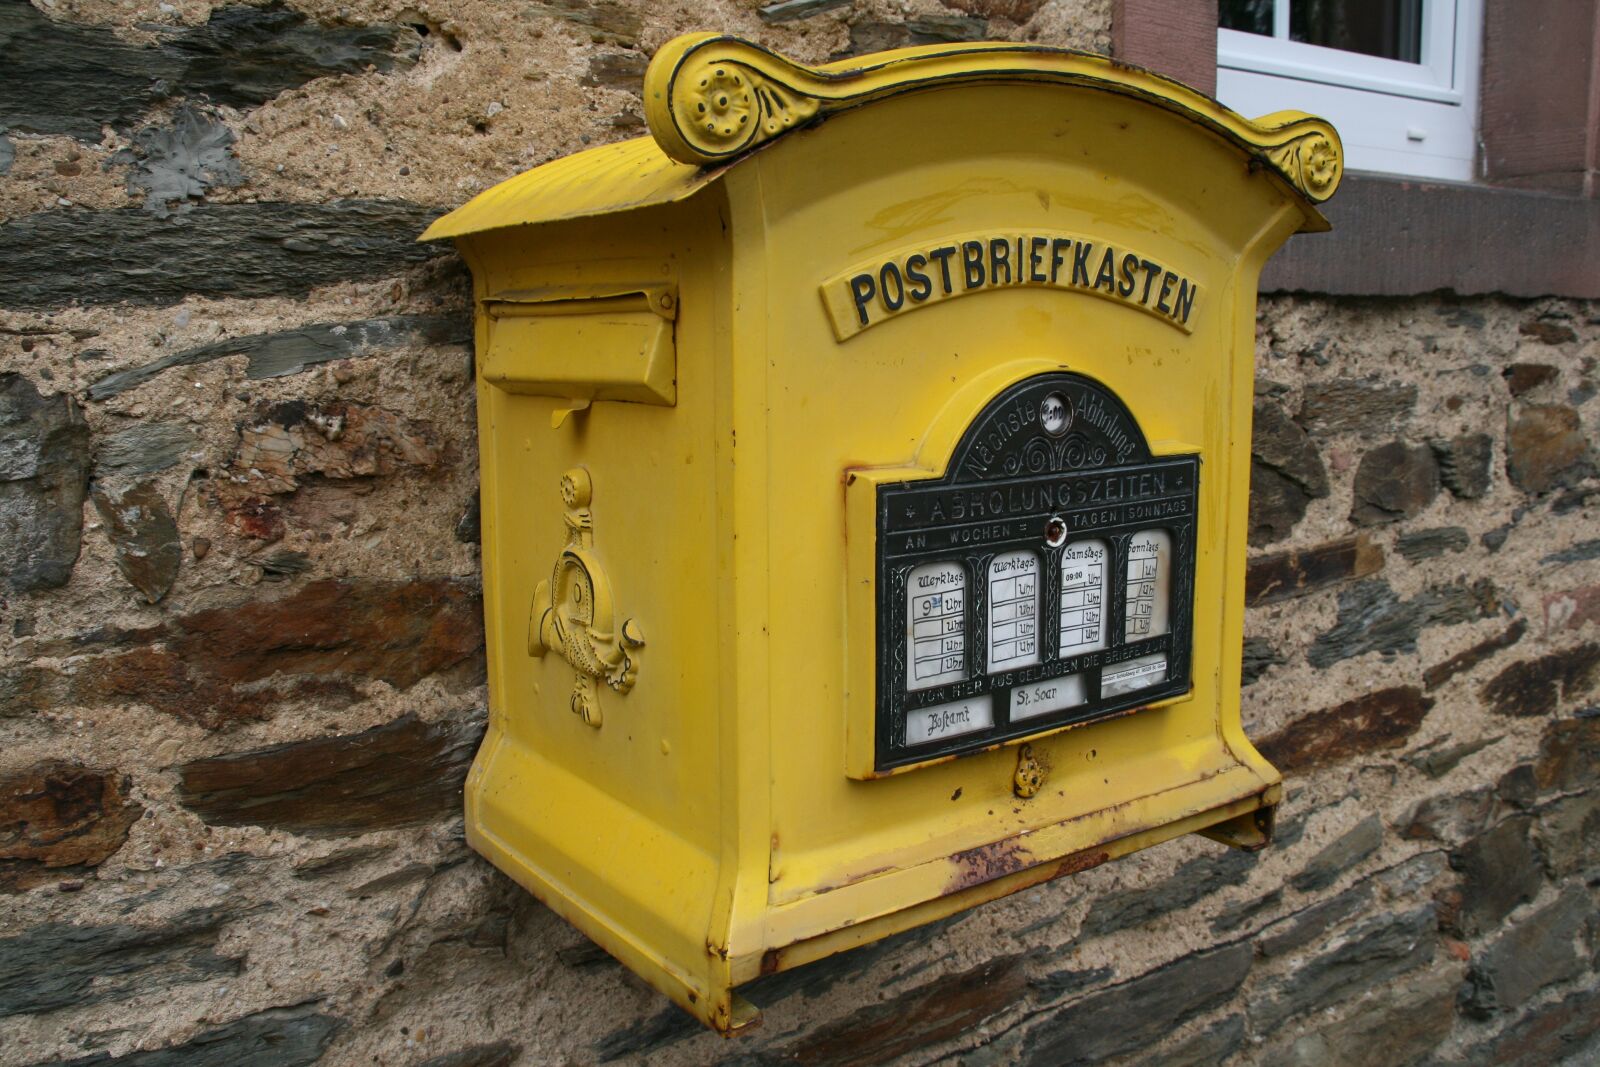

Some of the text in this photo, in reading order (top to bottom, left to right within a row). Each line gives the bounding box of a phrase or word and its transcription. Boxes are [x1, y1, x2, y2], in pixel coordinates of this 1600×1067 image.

[849, 236, 1197, 326] POSTBRIEFKASTEN
[966, 392, 1136, 479] Nächste Abholung
[930, 472, 1166, 521] ABHOLUNGSZEITEN
[1127, 500, 1187, 519] SONNTAGS
[905, 511, 1117, 550] AN WOCHEN TAGEN
[1065, 546, 1103, 562] Samstags
[992, 557, 1035, 573] Werktags
[918, 571, 963, 588] Werktags
[1066, 571, 1083, 582] 09:00
[1018, 583, 1034, 595] Uhr
[1086, 593, 1100, 604] Uhr
[945, 598, 962, 612] Uhr
[1019, 603, 1034, 615] Uhr
[1085, 611, 1099, 622] Uhr
[946, 619, 963, 630] Uhr
[1019, 622, 1034, 634] Uhr
[1085, 629, 1098, 640] Uhr
[946, 640, 962, 651] Uhr
[1019, 641, 1034, 652] Uhr
[946, 657, 962, 669] Uhr
[918, 639, 1168, 703] VON HIER AUS GELANGEN DIE BRIEFE ZUM
